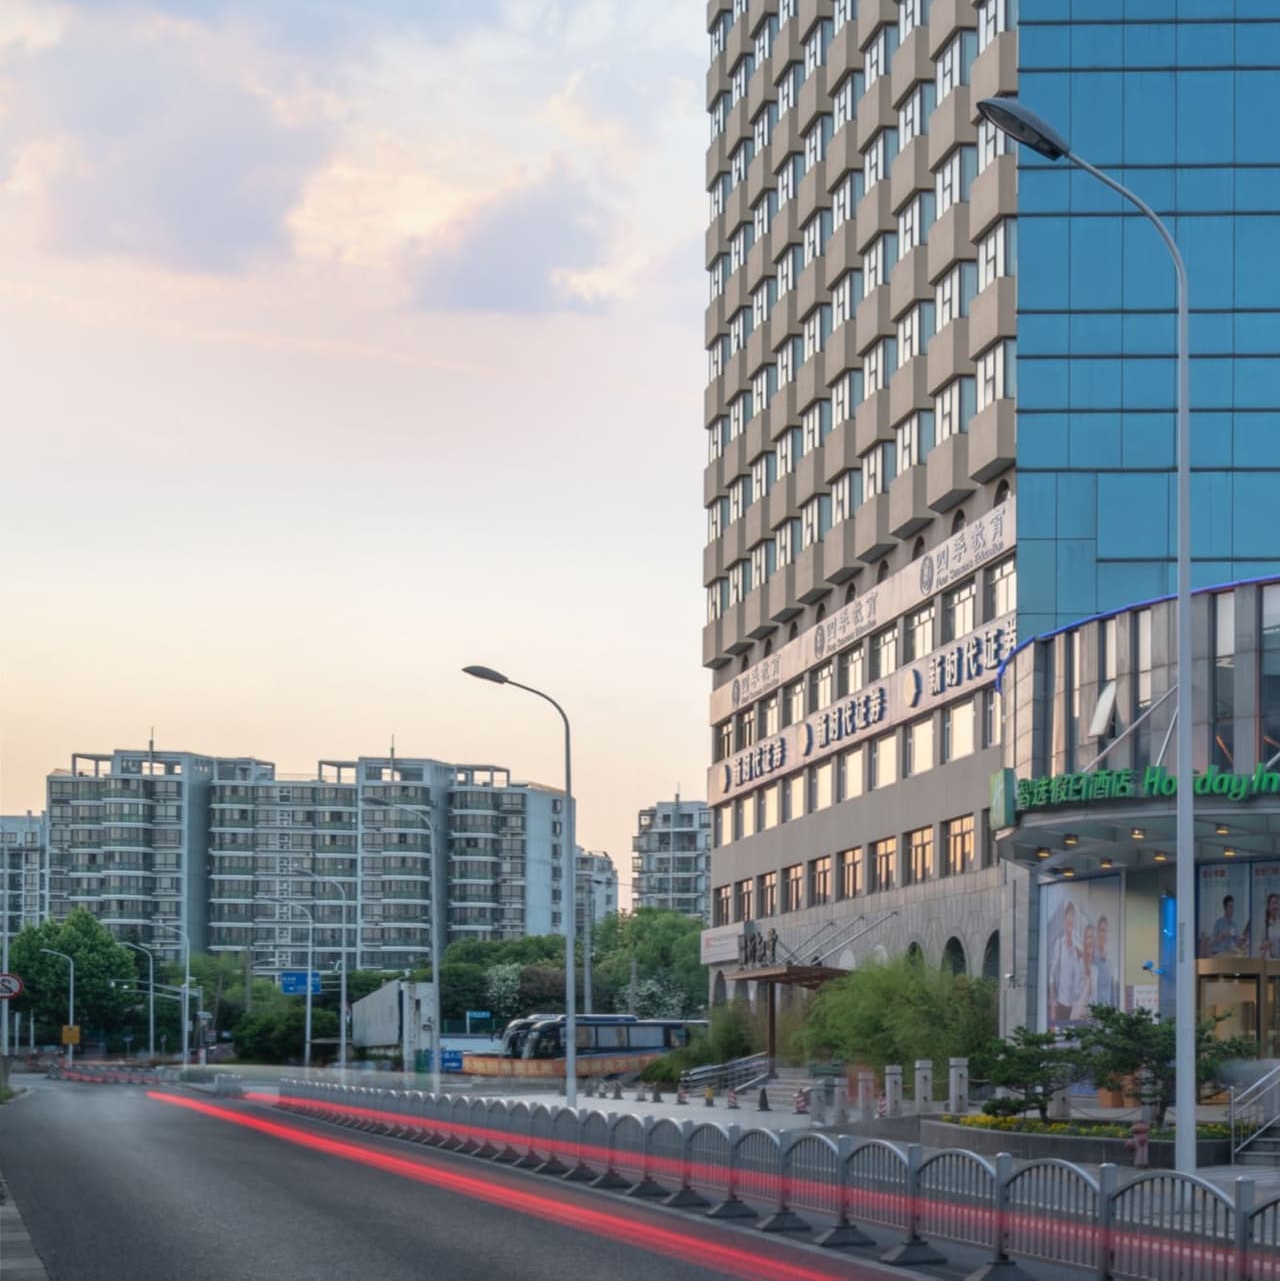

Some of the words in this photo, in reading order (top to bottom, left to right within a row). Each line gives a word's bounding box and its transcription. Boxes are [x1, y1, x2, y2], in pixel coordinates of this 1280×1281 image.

[817, 687, 887, 748] 新时代证券
[734, 737, 787, 787] 新时代证券
[1143, 765, 1247, 800] Hoday
[1017, 770, 1132, 808] 智选假日酒店
